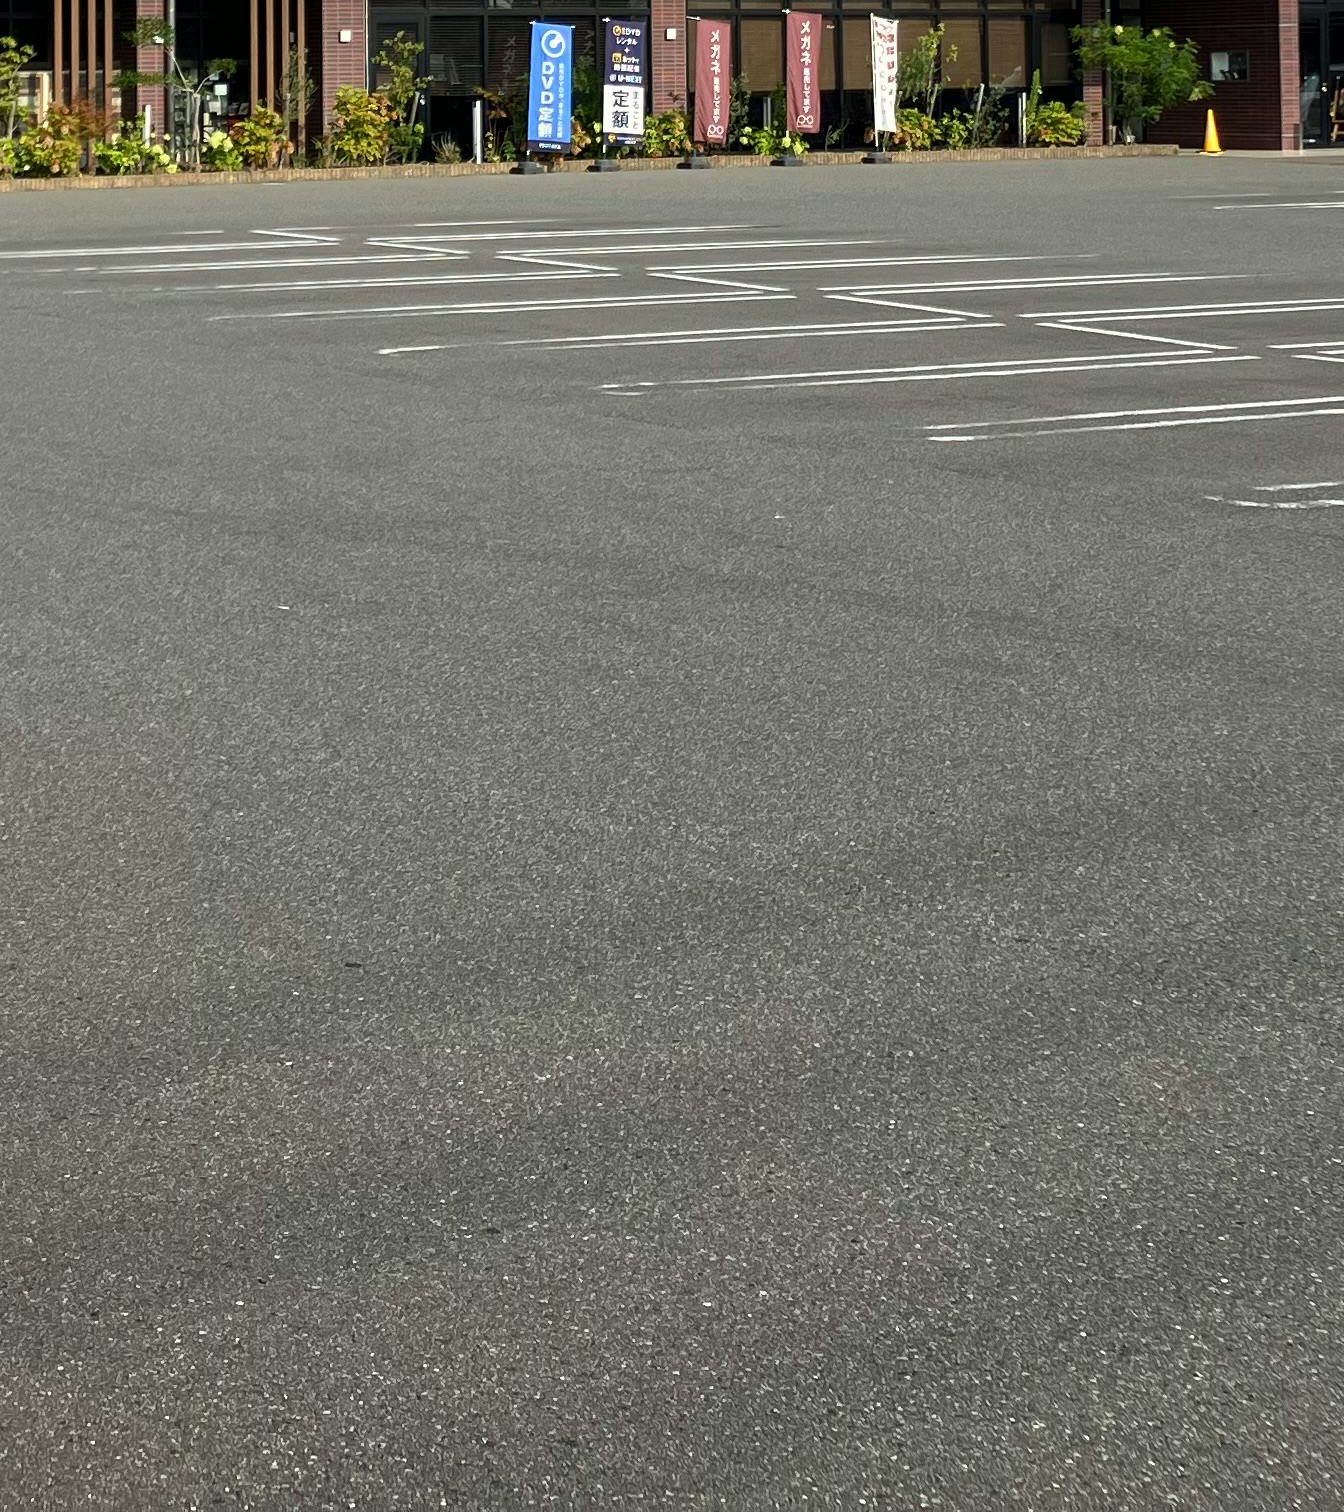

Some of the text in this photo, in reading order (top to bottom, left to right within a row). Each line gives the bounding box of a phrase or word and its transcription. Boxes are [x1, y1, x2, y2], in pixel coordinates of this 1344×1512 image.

[612, 90, 629, 128] 定額
[631, 91, 640, 129] まるごと
